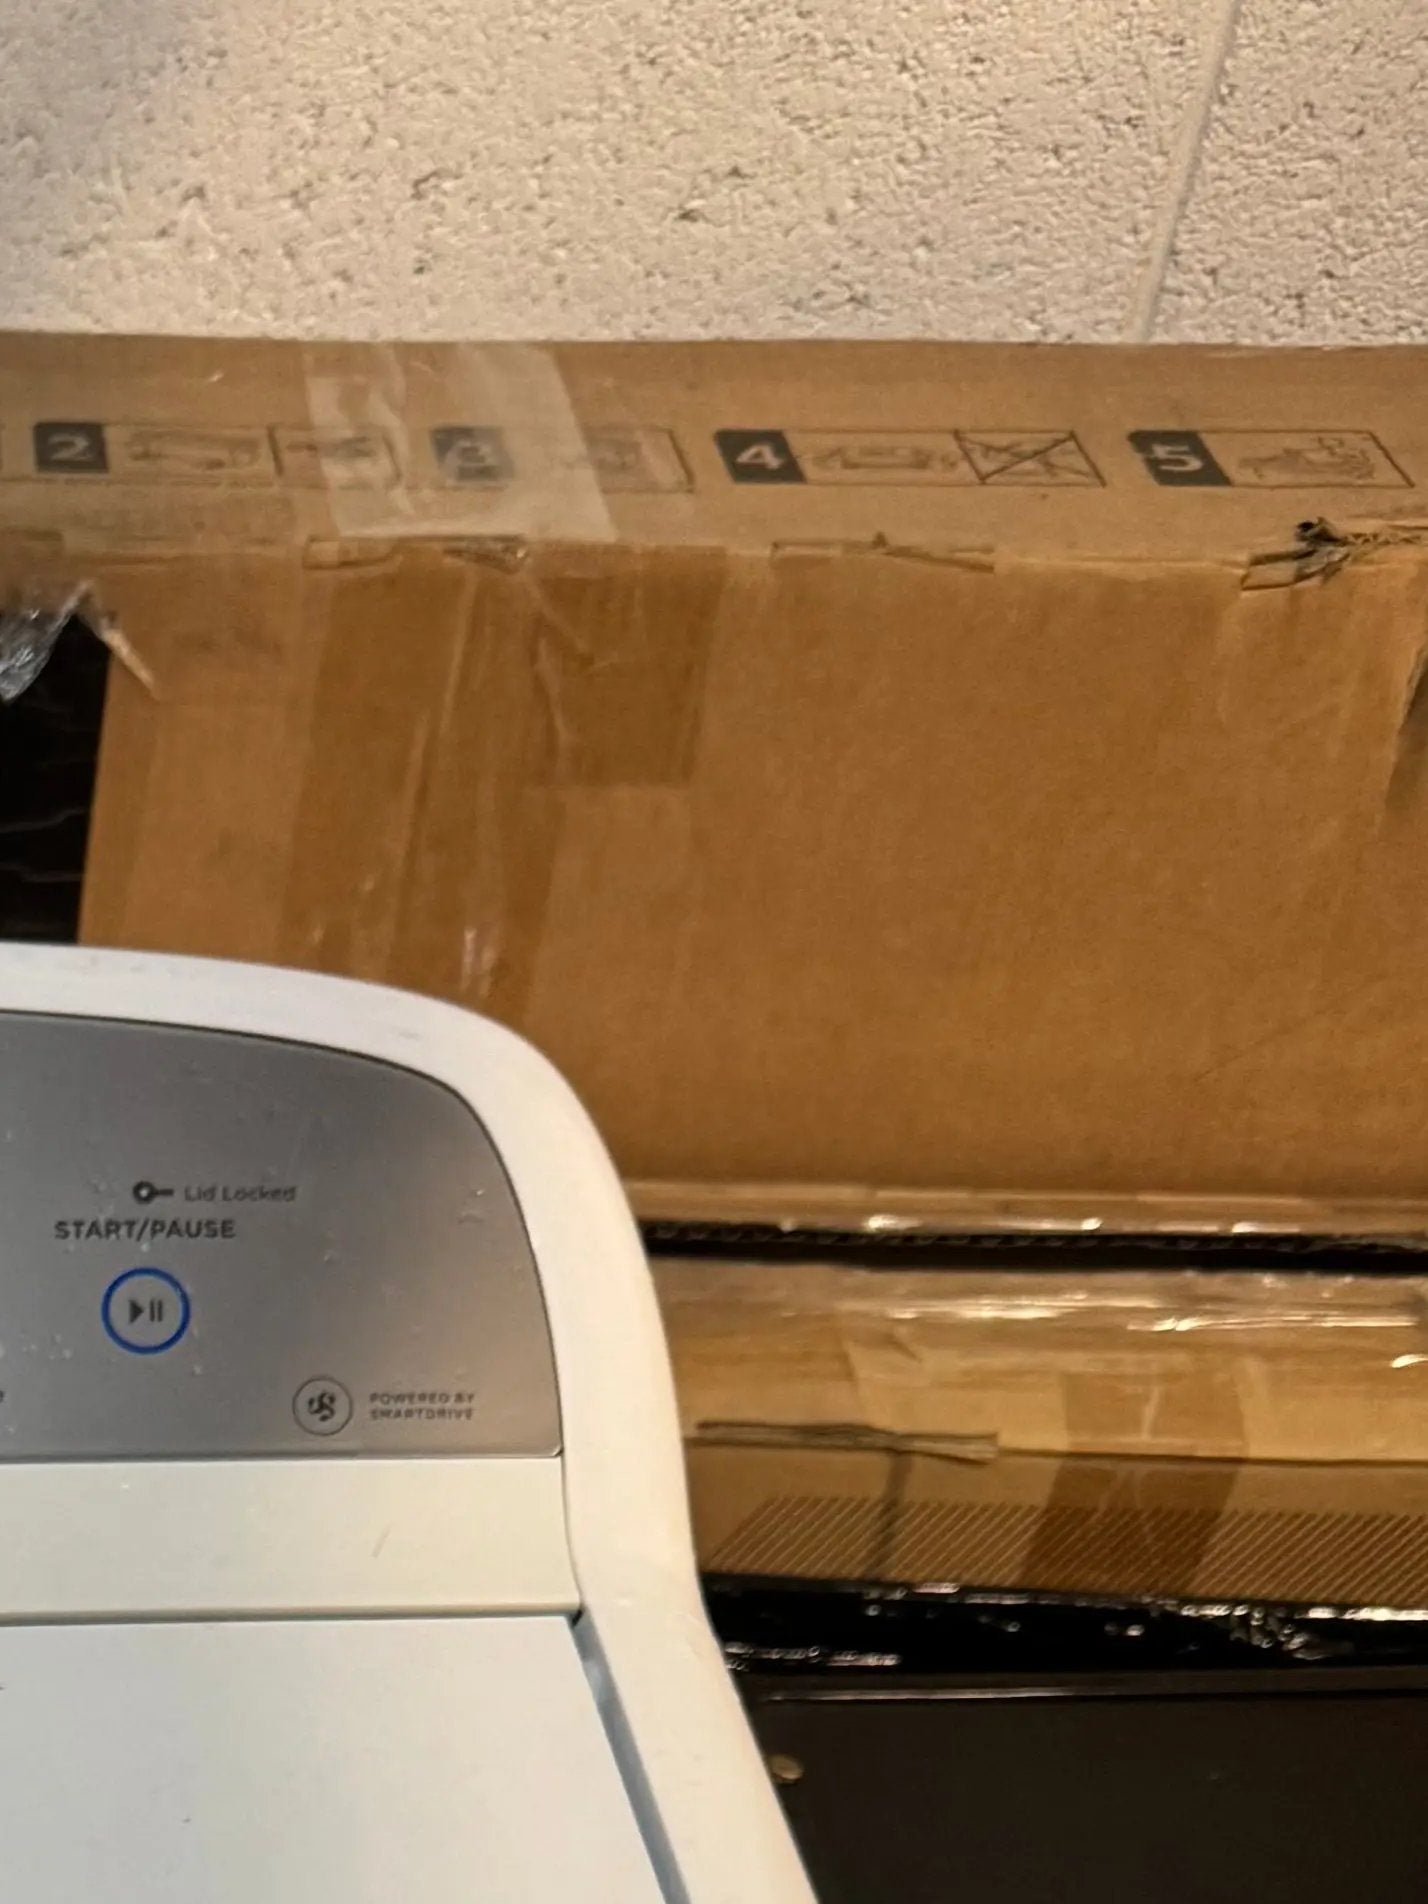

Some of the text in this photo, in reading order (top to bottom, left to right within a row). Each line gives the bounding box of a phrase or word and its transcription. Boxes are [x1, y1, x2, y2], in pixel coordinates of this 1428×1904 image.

[46, 433, 94, 461] 2
[735, 444, 784, 470] 4
[1150, 443, 1207, 473] 5
[183, 1183, 297, 1201] Lid Locked
[54, 1219, 236, 1240] START/PAUSE
